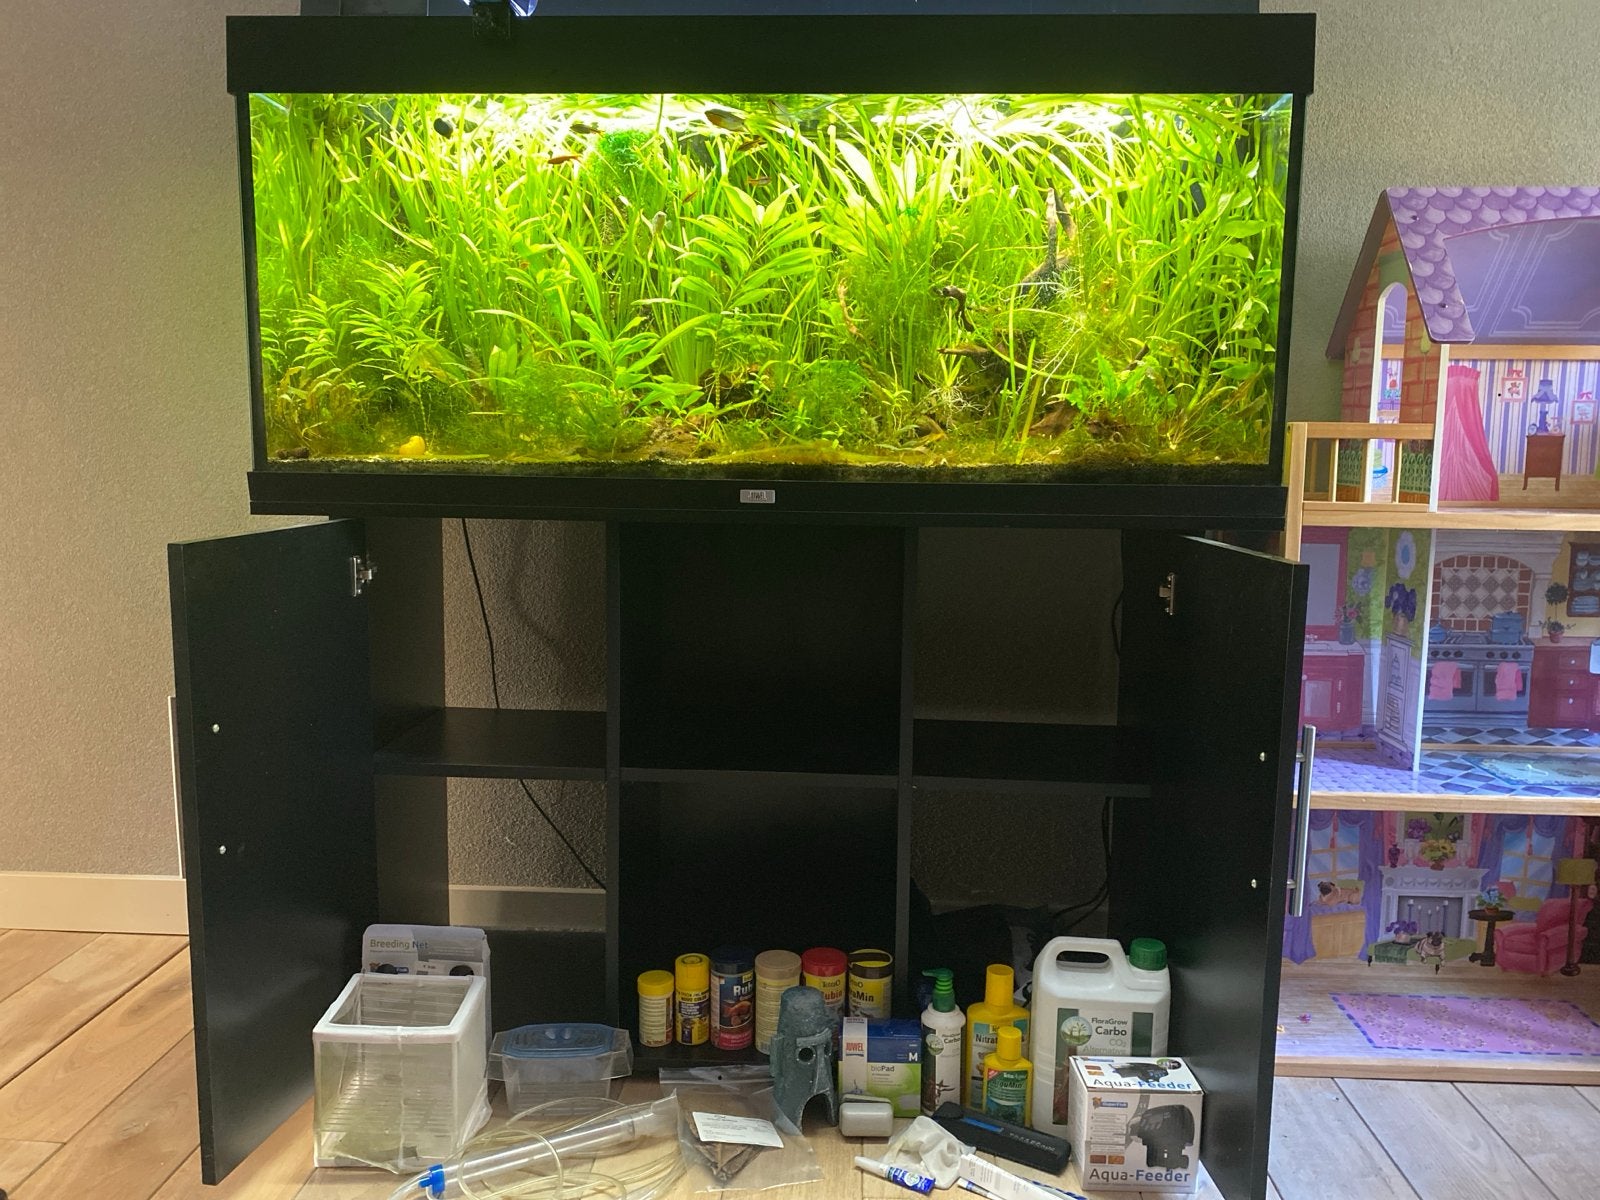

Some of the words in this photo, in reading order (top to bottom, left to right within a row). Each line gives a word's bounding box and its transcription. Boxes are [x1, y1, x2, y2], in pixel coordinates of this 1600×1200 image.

[369, 938, 410, 950] Breeding
[412, 939, 428, 949] Net
[733, 983, 752, 997] Rub
[824, 990, 843, 1001] ubin
[1091, 1017, 1128, 1025] FloraGrow
[1095, 1026, 1127, 1036] Carbo
[846, 1042, 864, 1052] JUWEL
[908, 1052, 918, 1061] M
[1093, 1078, 1192, 1090] Aqua-Feeder
[1088, 1167, 1191, 1181] Aqua-Feeder
